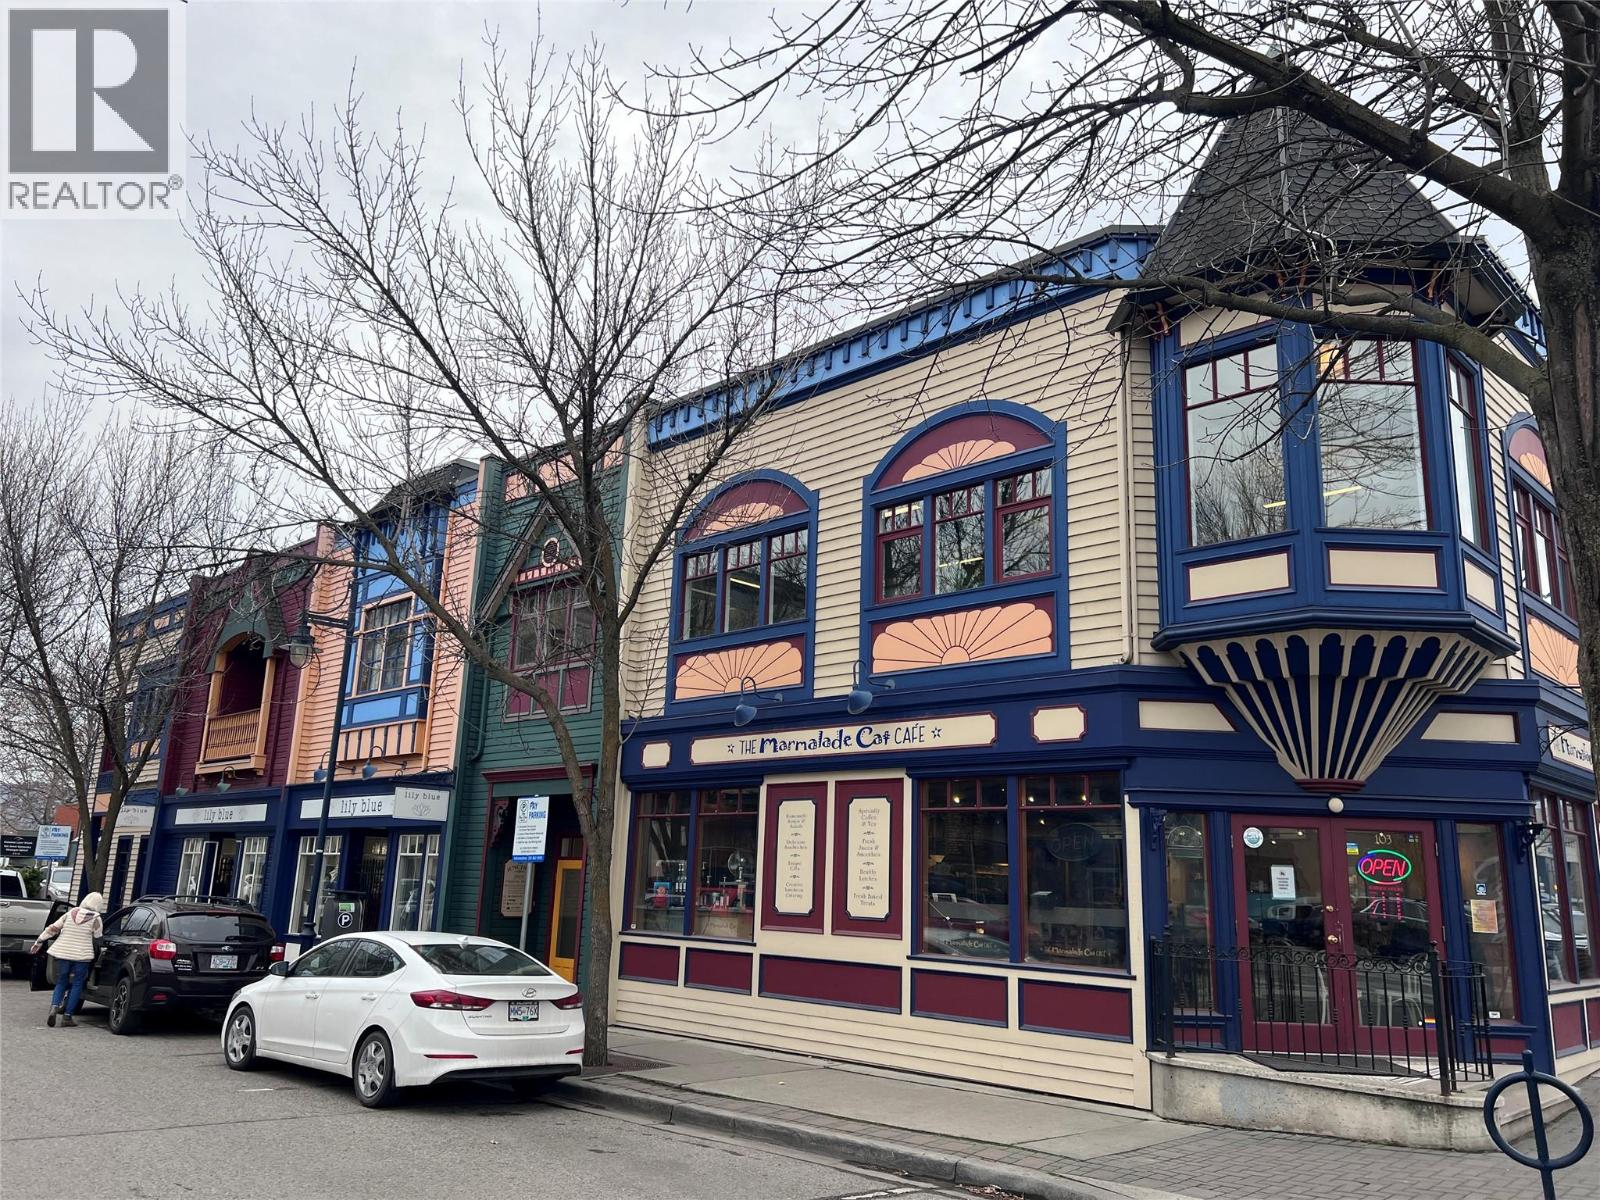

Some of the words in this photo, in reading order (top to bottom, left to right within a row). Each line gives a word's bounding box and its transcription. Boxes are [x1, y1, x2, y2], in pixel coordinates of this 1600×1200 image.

[739, 739, 757, 755] THE
[759, 728, 852, 754] Marmalade
[856, 726, 891, 749] Cat
[894, 723, 925, 745] CAFÉ
[404, 791, 420, 800] lily
[422, 791, 441, 801] blue
[340, 799, 358, 816] lily
[361, 798, 383, 813] blue
[203, 809, 217, 822] lily
[218, 808, 234, 820] blue
[529, 811, 546, 819] PARKING
[1375, 833, 1393, 845] 103
[1360, 858, 1406, 877] OPEN
